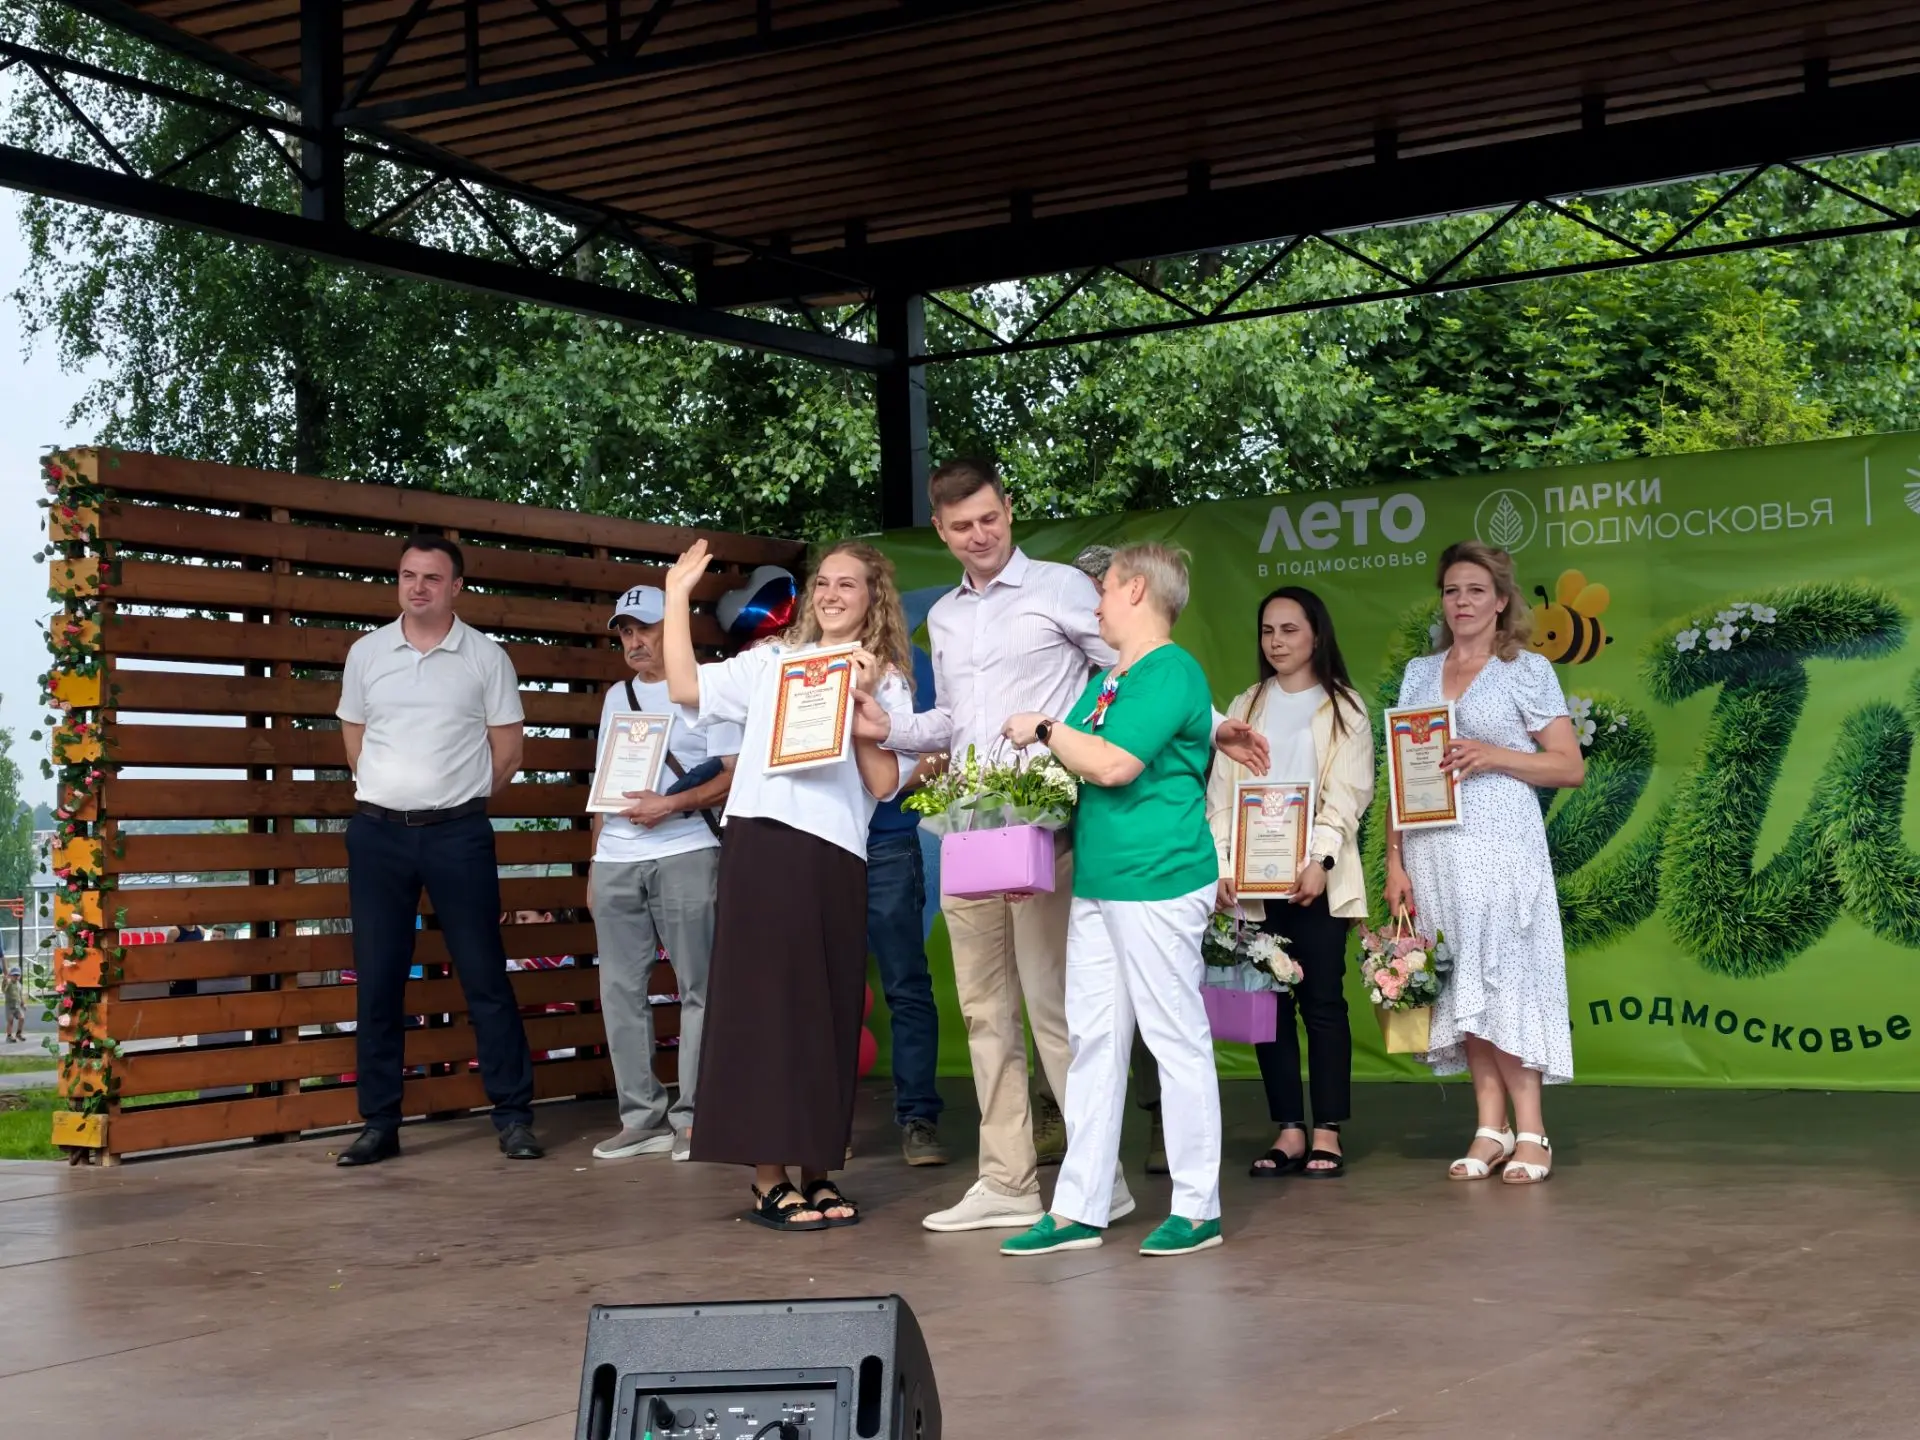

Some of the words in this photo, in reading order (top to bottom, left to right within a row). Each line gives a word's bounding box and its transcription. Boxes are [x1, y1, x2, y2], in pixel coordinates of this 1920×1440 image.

[1544, 477, 1662, 514] ПАРКИ
[1545, 497, 1834, 549] ПОДМОСКОВЬЯ
[1276, 551, 1428, 576] подмосковье
[624, 590, 643, 607] H
